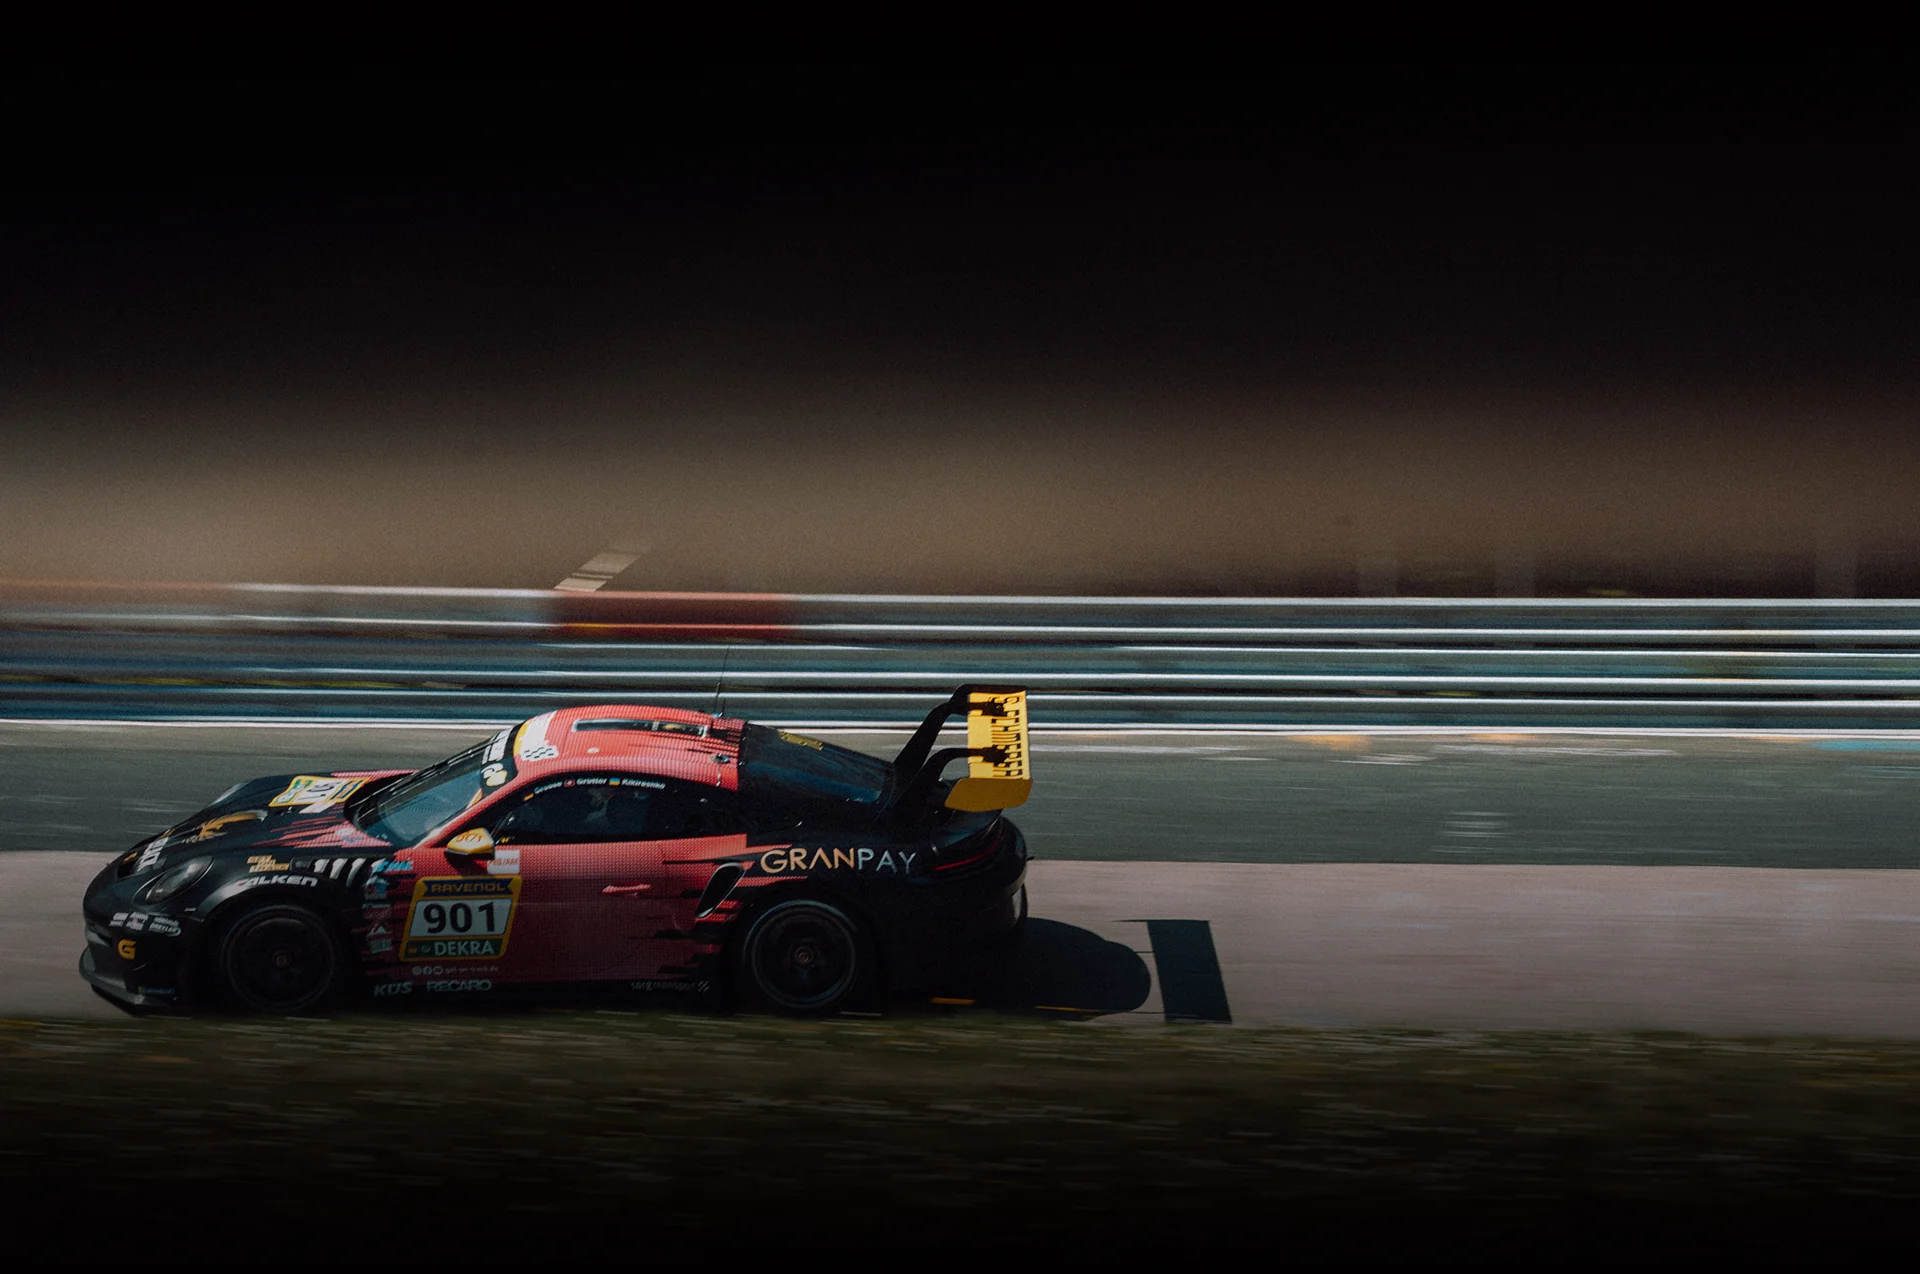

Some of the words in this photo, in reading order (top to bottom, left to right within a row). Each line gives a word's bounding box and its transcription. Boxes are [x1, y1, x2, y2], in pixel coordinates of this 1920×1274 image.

[760, 846, 917, 875] GRANPAY
[430, 882, 506, 893] RAVENOL
[423, 902, 495, 934] 901
[434, 940, 495, 956] DEKRA
[425, 979, 493, 993] RECARO
